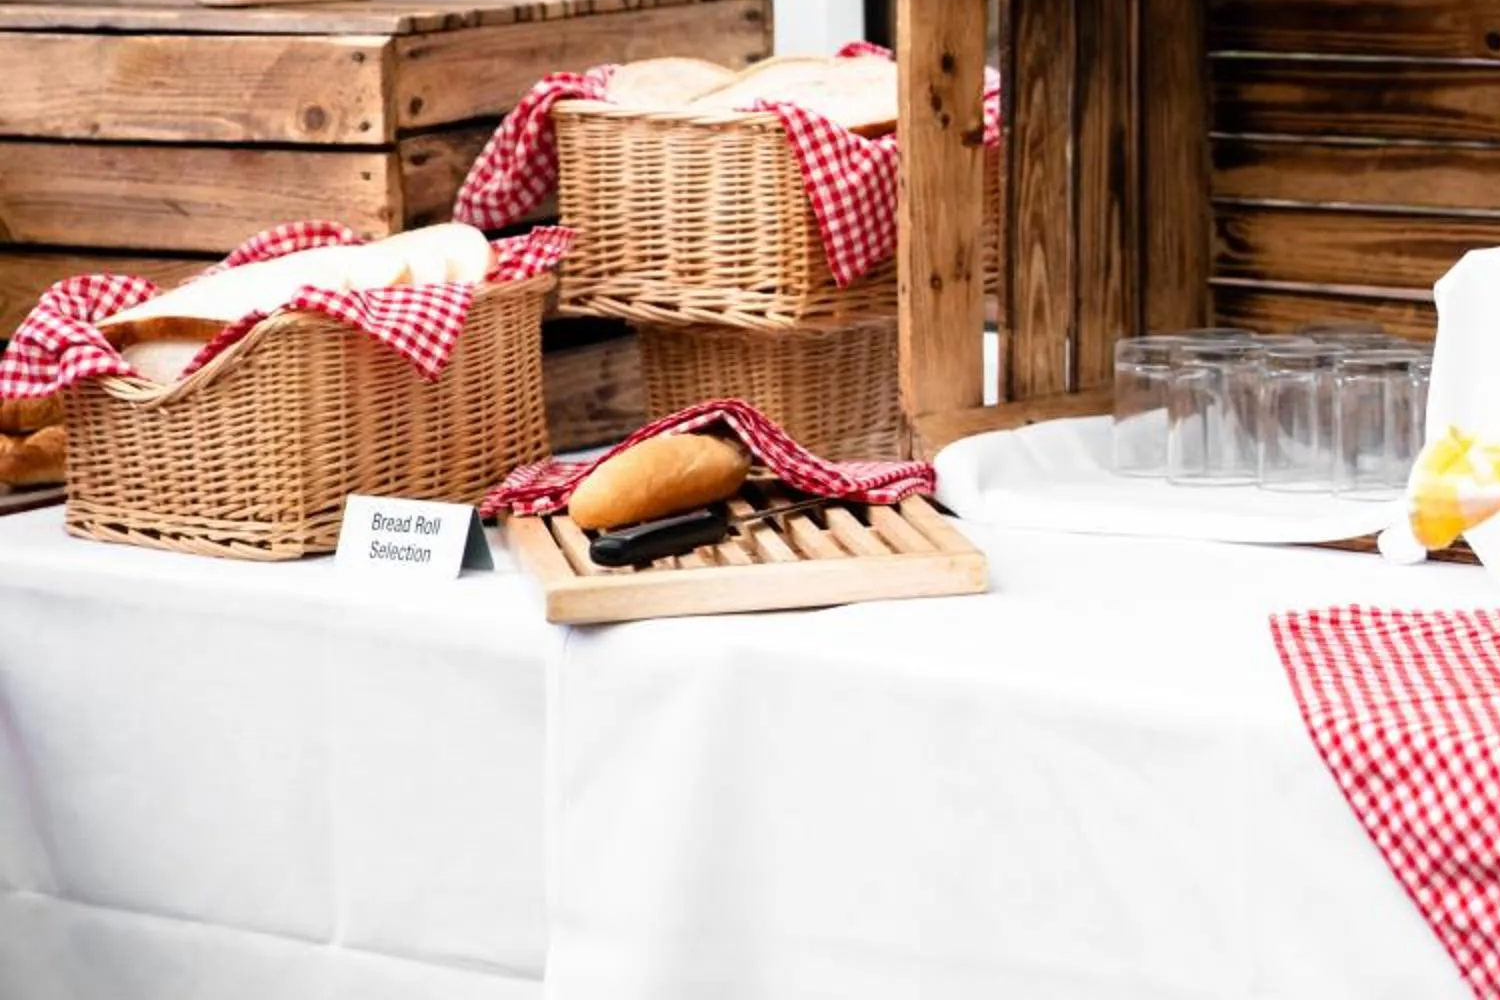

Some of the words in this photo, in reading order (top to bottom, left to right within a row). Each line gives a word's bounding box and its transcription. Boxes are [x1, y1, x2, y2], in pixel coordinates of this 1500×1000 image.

[371, 512, 413, 533] Bread
[414, 515, 441, 535] Roll
[369, 540, 432, 563] Selection
